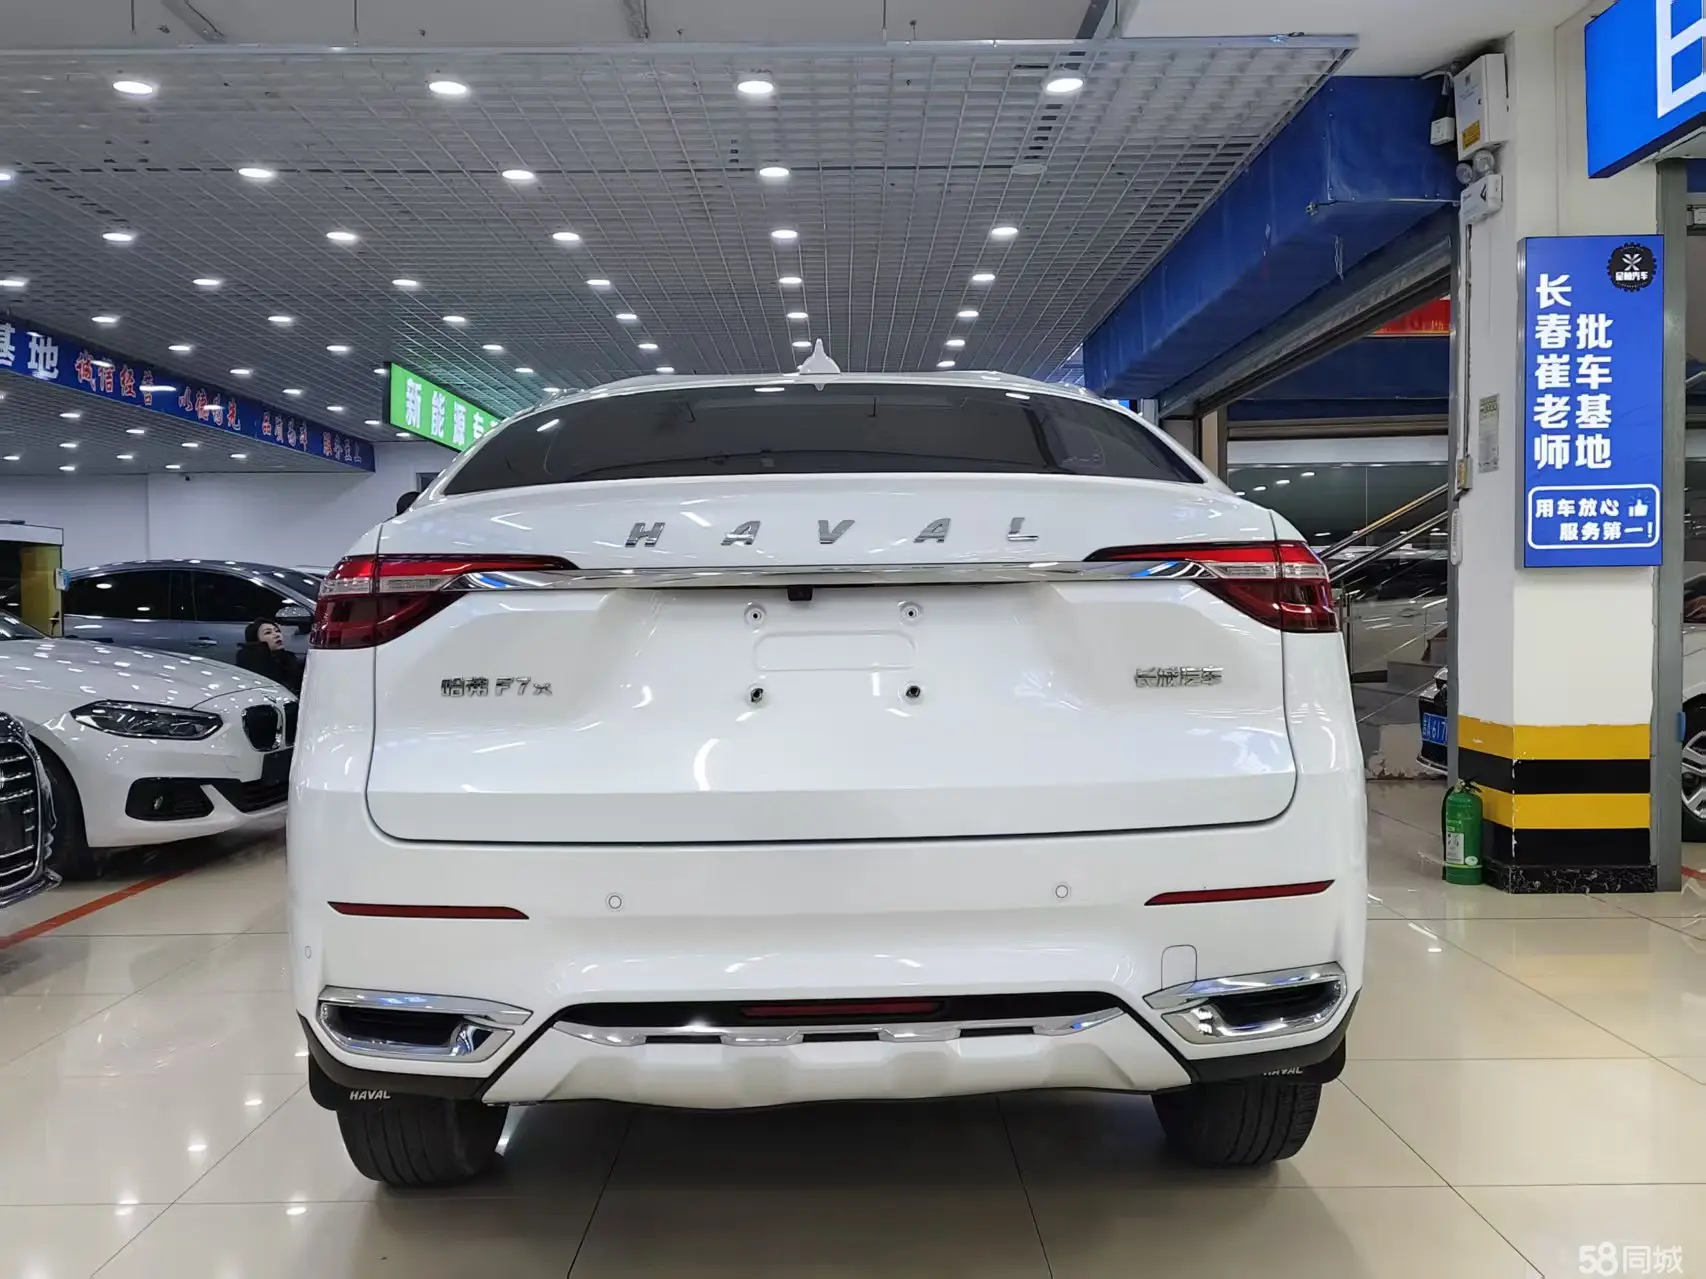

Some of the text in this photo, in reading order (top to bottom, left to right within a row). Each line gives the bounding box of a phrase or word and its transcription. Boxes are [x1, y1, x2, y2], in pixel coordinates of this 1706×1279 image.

[1533, 273, 1572, 469] 长春崔老师
[1575, 313, 1614, 469] 批车基地
[405, 377, 499, 446] 新能源
[1535, 497, 1619, 518] 用车放心
[624, 517, 1039, 547] HAVAL
[1559, 521, 1653, 541] 服务第一!
[349, 1089, 391, 1100] HAVAL
